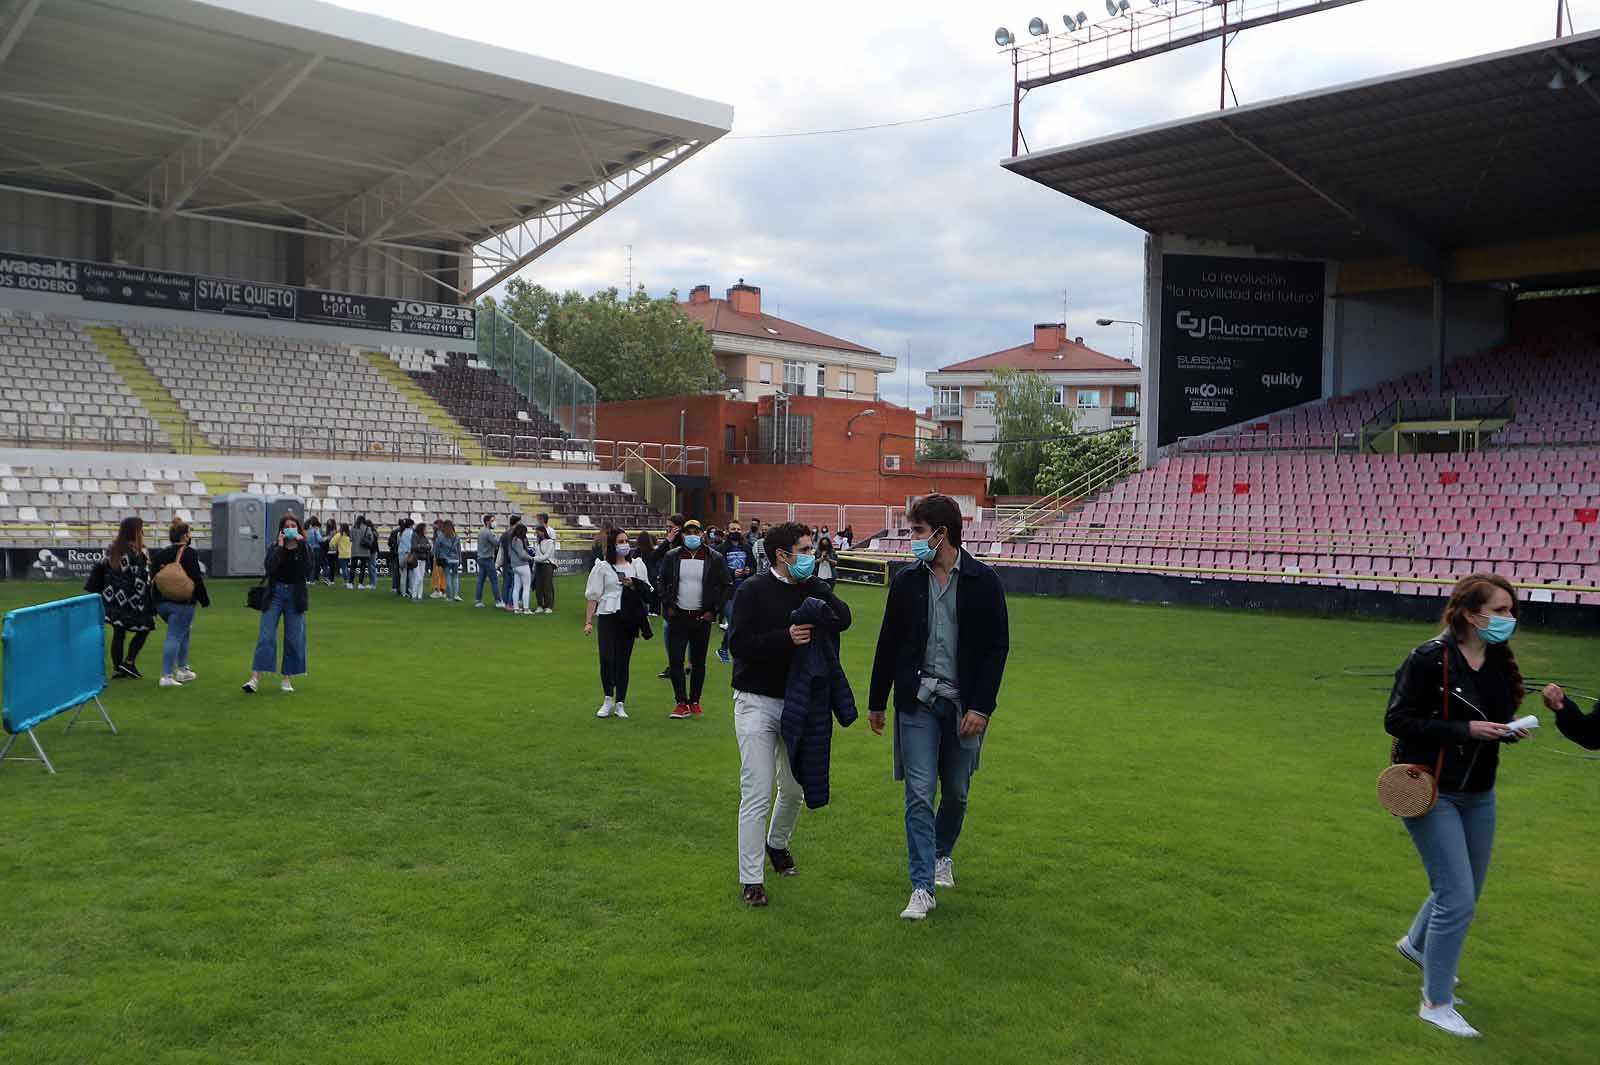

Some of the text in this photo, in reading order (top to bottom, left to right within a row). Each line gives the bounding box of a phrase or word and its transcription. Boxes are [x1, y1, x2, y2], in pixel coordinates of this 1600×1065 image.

[18, 276, 77, 293] BODERO
[198, 280, 241, 302] STATE
[244, 286, 294, 308] QUIETO
[391, 301, 473, 322] JOFER
[1261, 372, 1303, 389] quikly
